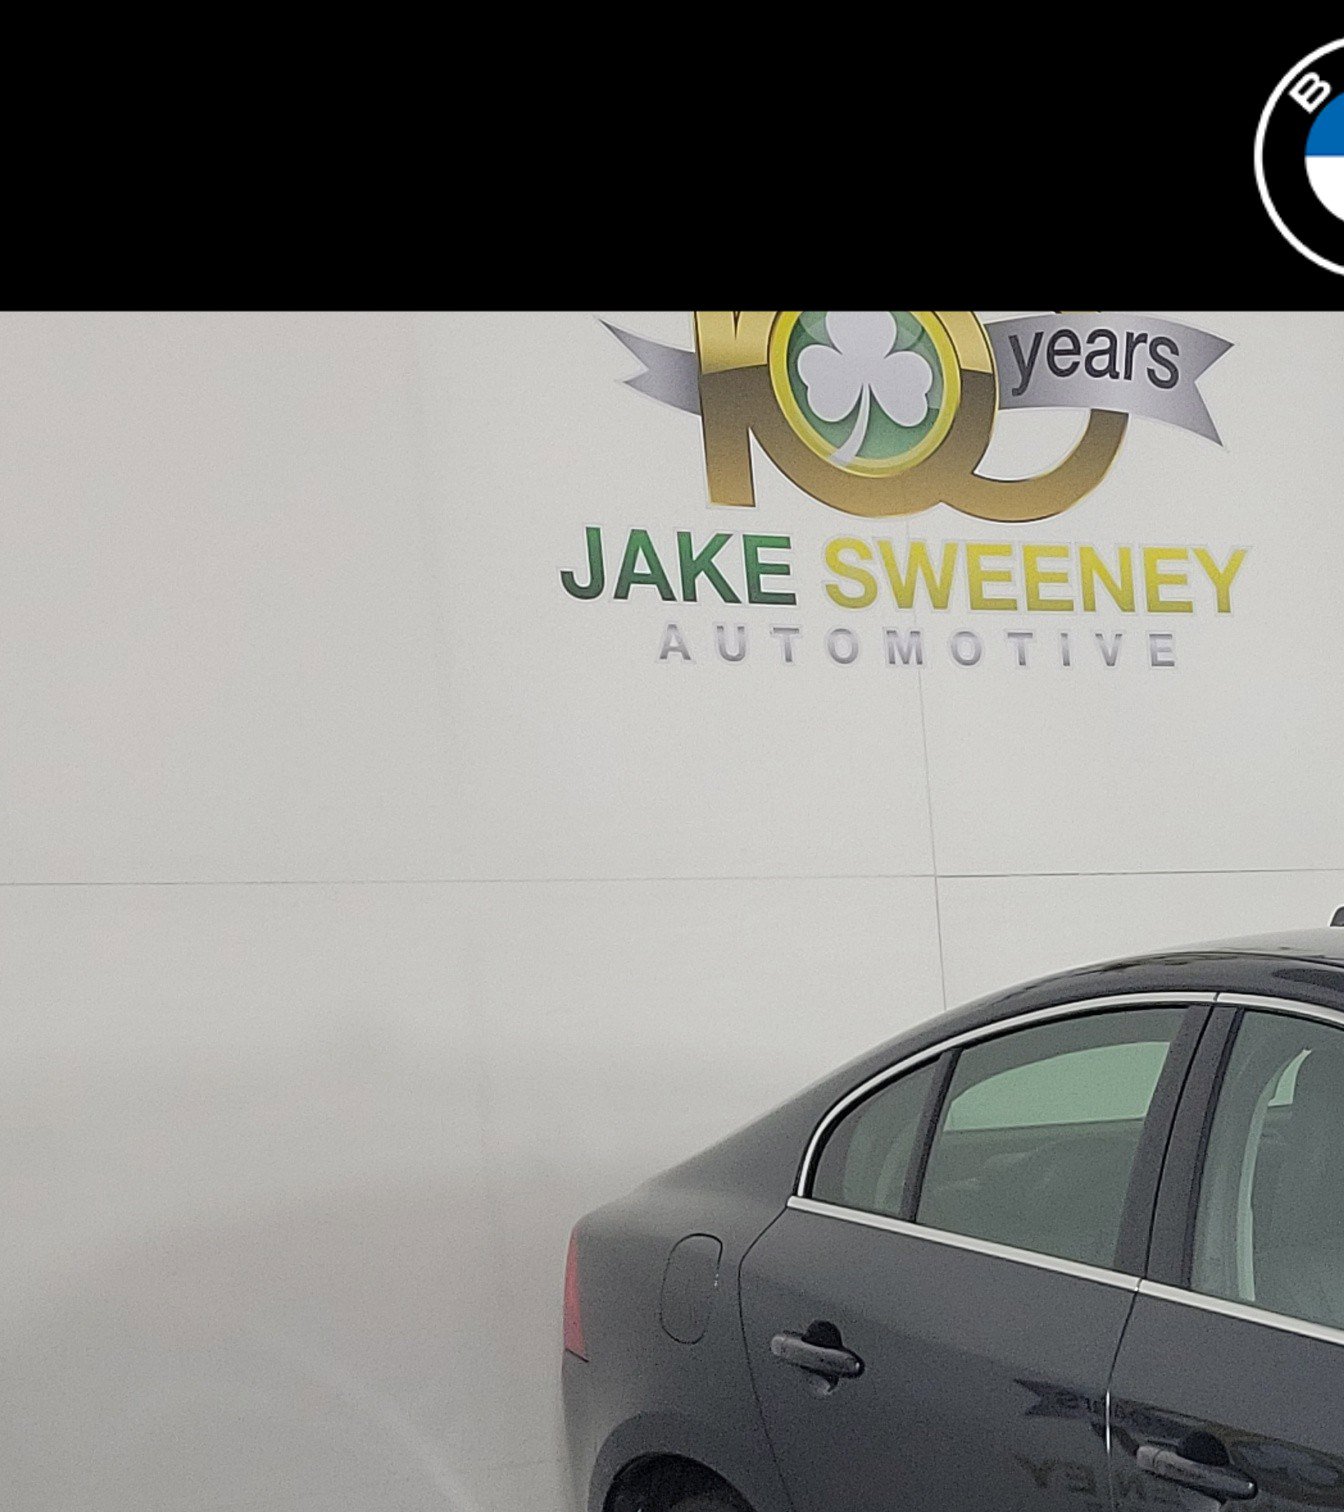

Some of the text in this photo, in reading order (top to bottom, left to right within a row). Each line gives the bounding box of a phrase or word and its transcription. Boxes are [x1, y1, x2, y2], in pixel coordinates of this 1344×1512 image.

[1009, 328, 1180, 398] years
[560, 526, 1248, 614] JAKE SWEENEY
[659, 624, 1176, 667] AUTOMOTIVE
